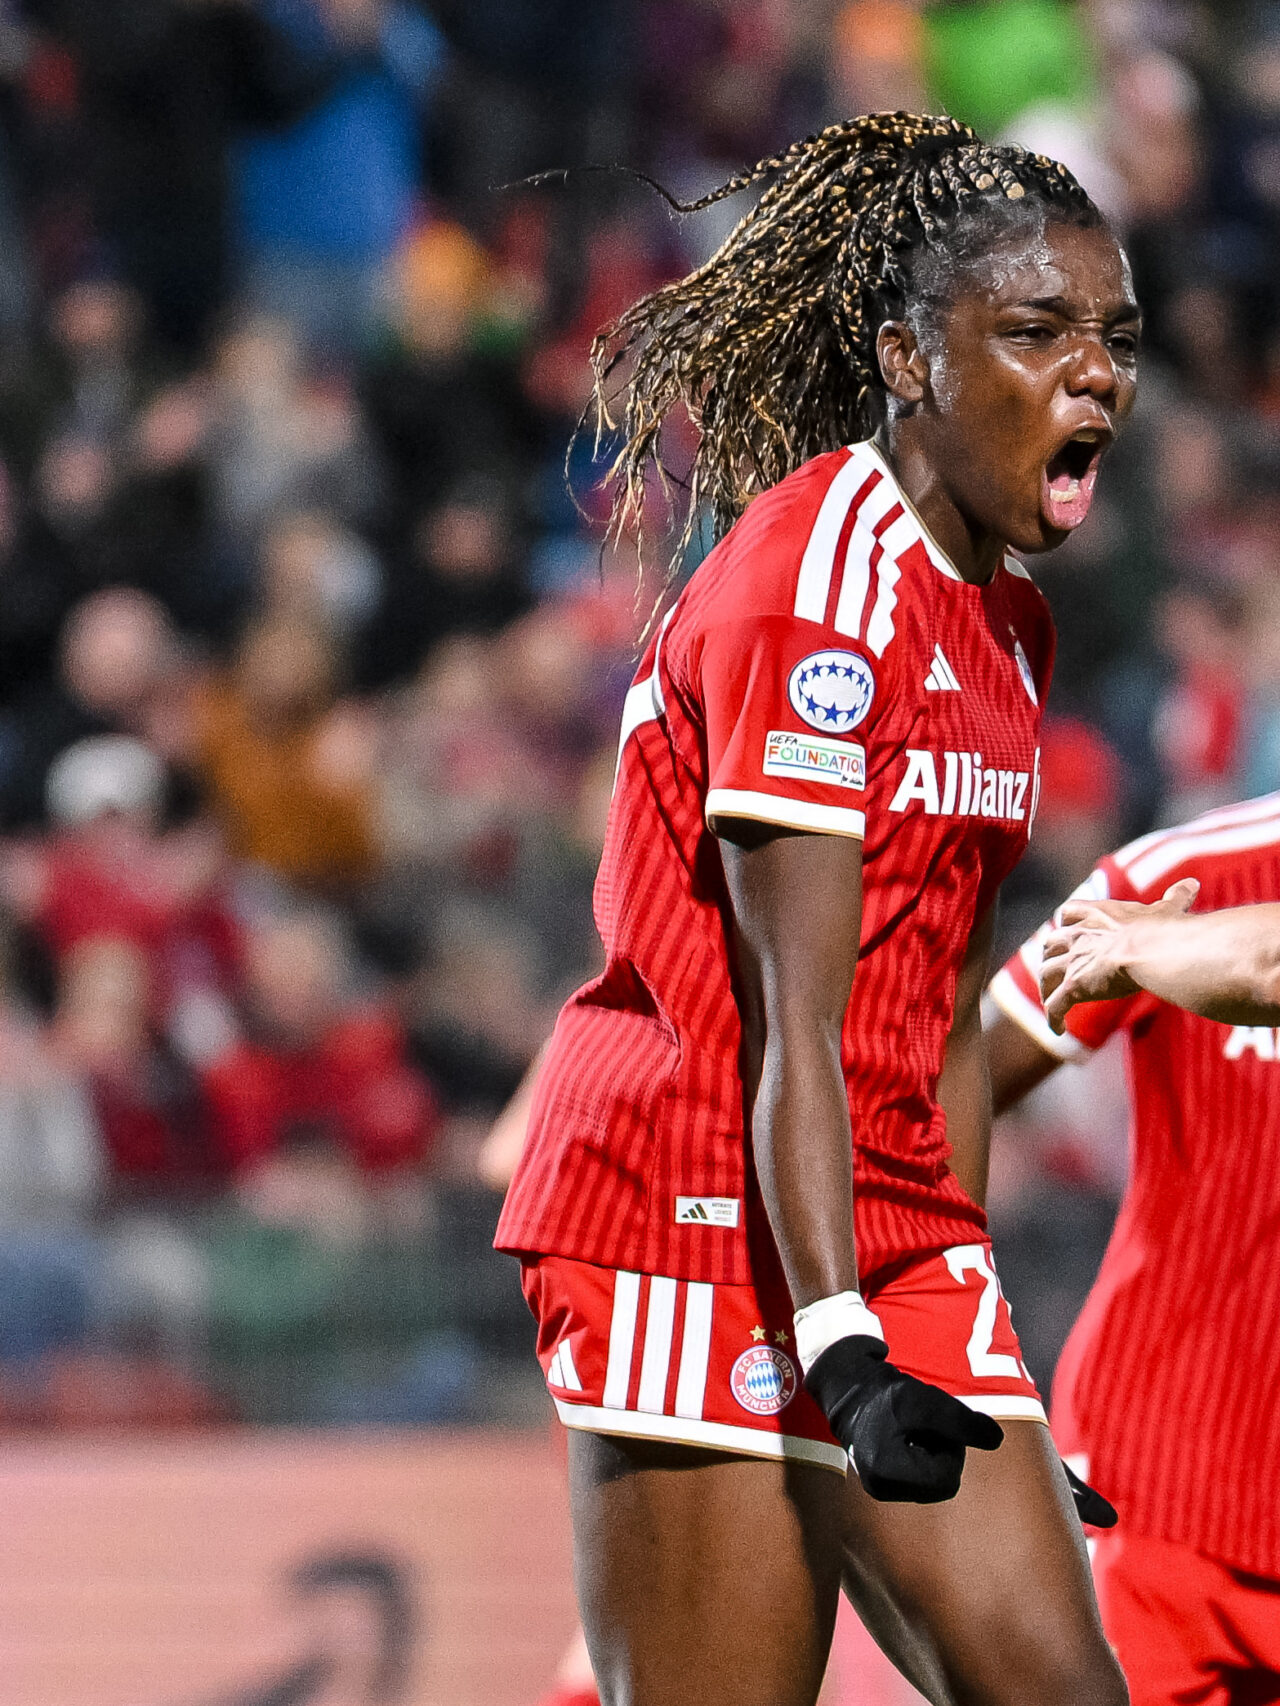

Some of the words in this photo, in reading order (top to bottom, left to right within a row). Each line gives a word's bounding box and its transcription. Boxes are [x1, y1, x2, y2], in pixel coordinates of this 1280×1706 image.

[769, 734, 798, 745] UEFA
[768, 745, 864, 775] FOUNDATION
[887, 748, 1029, 821] Allianz
[737, 1358, 752, 1375] FC
[752, 1350, 793, 1378] BAYERN
